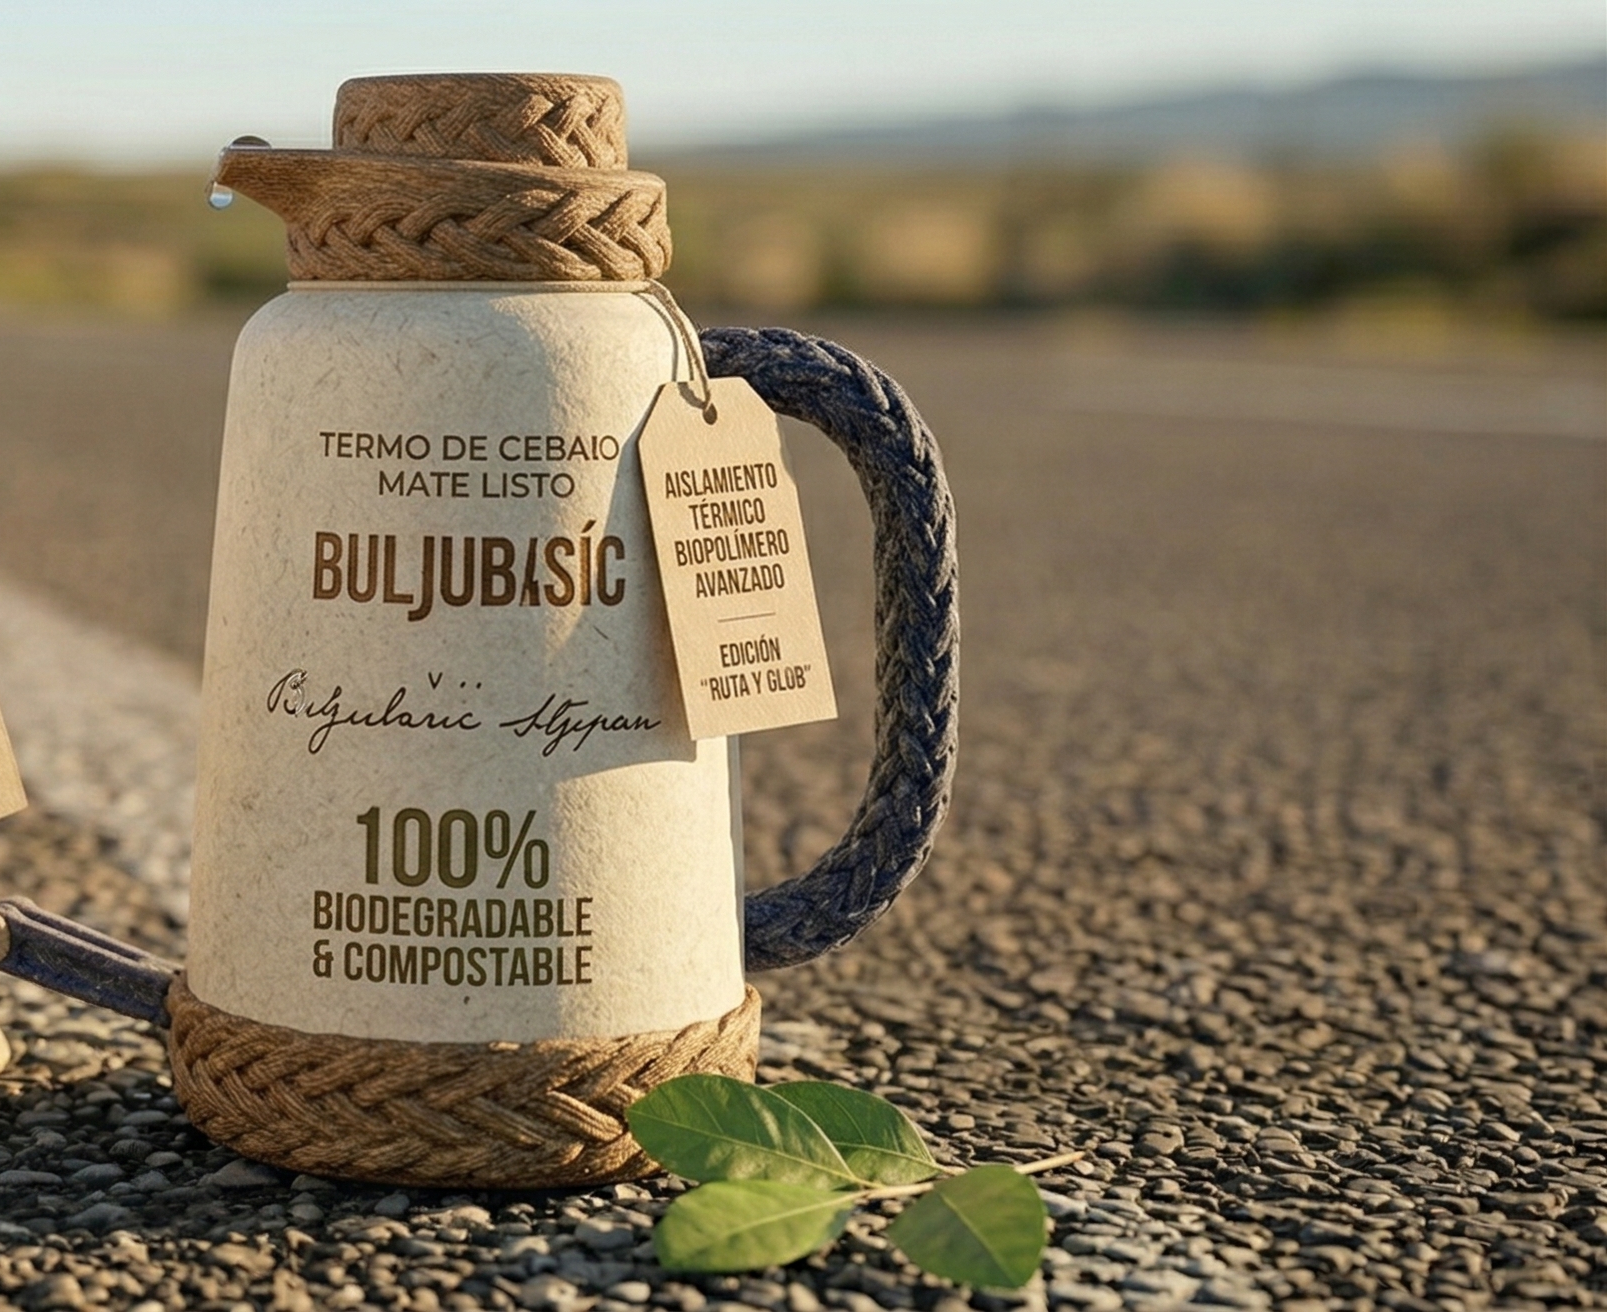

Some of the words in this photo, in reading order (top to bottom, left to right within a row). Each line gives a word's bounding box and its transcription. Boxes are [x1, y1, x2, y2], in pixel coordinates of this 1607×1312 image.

[319, 431, 431, 460] TERMO
[442, 435, 488, 461] DE
[378, 470, 470, 498] MATE
[482, 472, 575, 499] LISTO
[665, 462, 778, 499] AISLAMIENTO
[688, 497, 766, 531] TÉRMICO
[674, 528, 790, 567] BIOPOLÍMERO
[696, 563, 785, 599] AVANZADO
[719, 634, 782, 668] EDICIÓN
[751, 671, 762, 695] Y
[356, 806, 550, 889] 100%
[313, 890, 594, 938] BIODEGRADABLE
[313, 938, 334, 979] &
[344, 941, 593, 987] COMPOSTABLE
